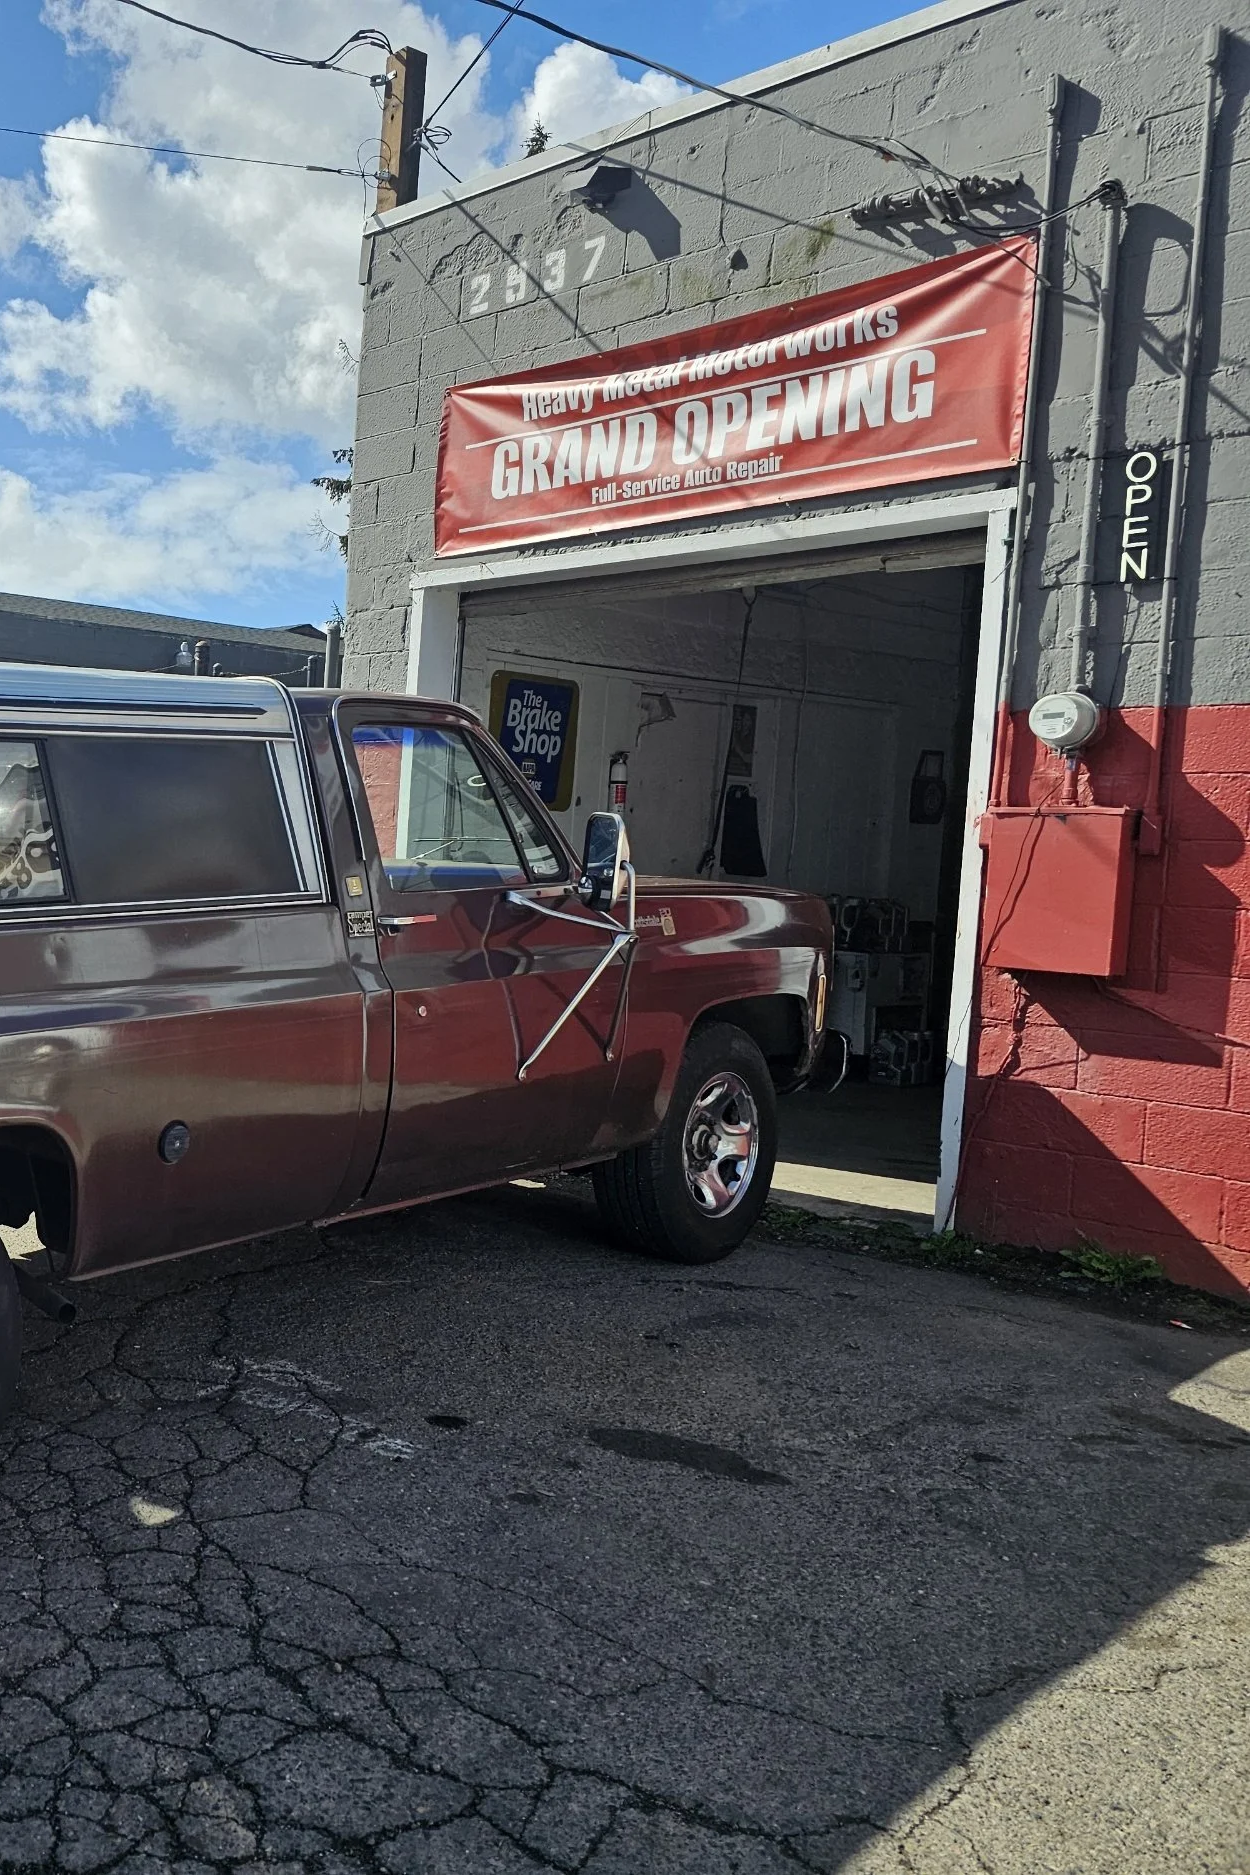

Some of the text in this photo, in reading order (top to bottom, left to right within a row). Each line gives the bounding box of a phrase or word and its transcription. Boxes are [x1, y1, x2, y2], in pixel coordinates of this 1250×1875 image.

[522, 304, 899, 422] Heavy Metal Motorworks
[491, 349, 936, 499] GRAND OPENING
[591, 452, 784, 504] Full-Service Auto Repair
[1119, 451, 1157, 583] OPEN
[507, 698, 562, 732] Brake
[523, 689, 543, 708] The
[512, 724, 562, 763] Shop
[348, 919, 375, 937] Special
